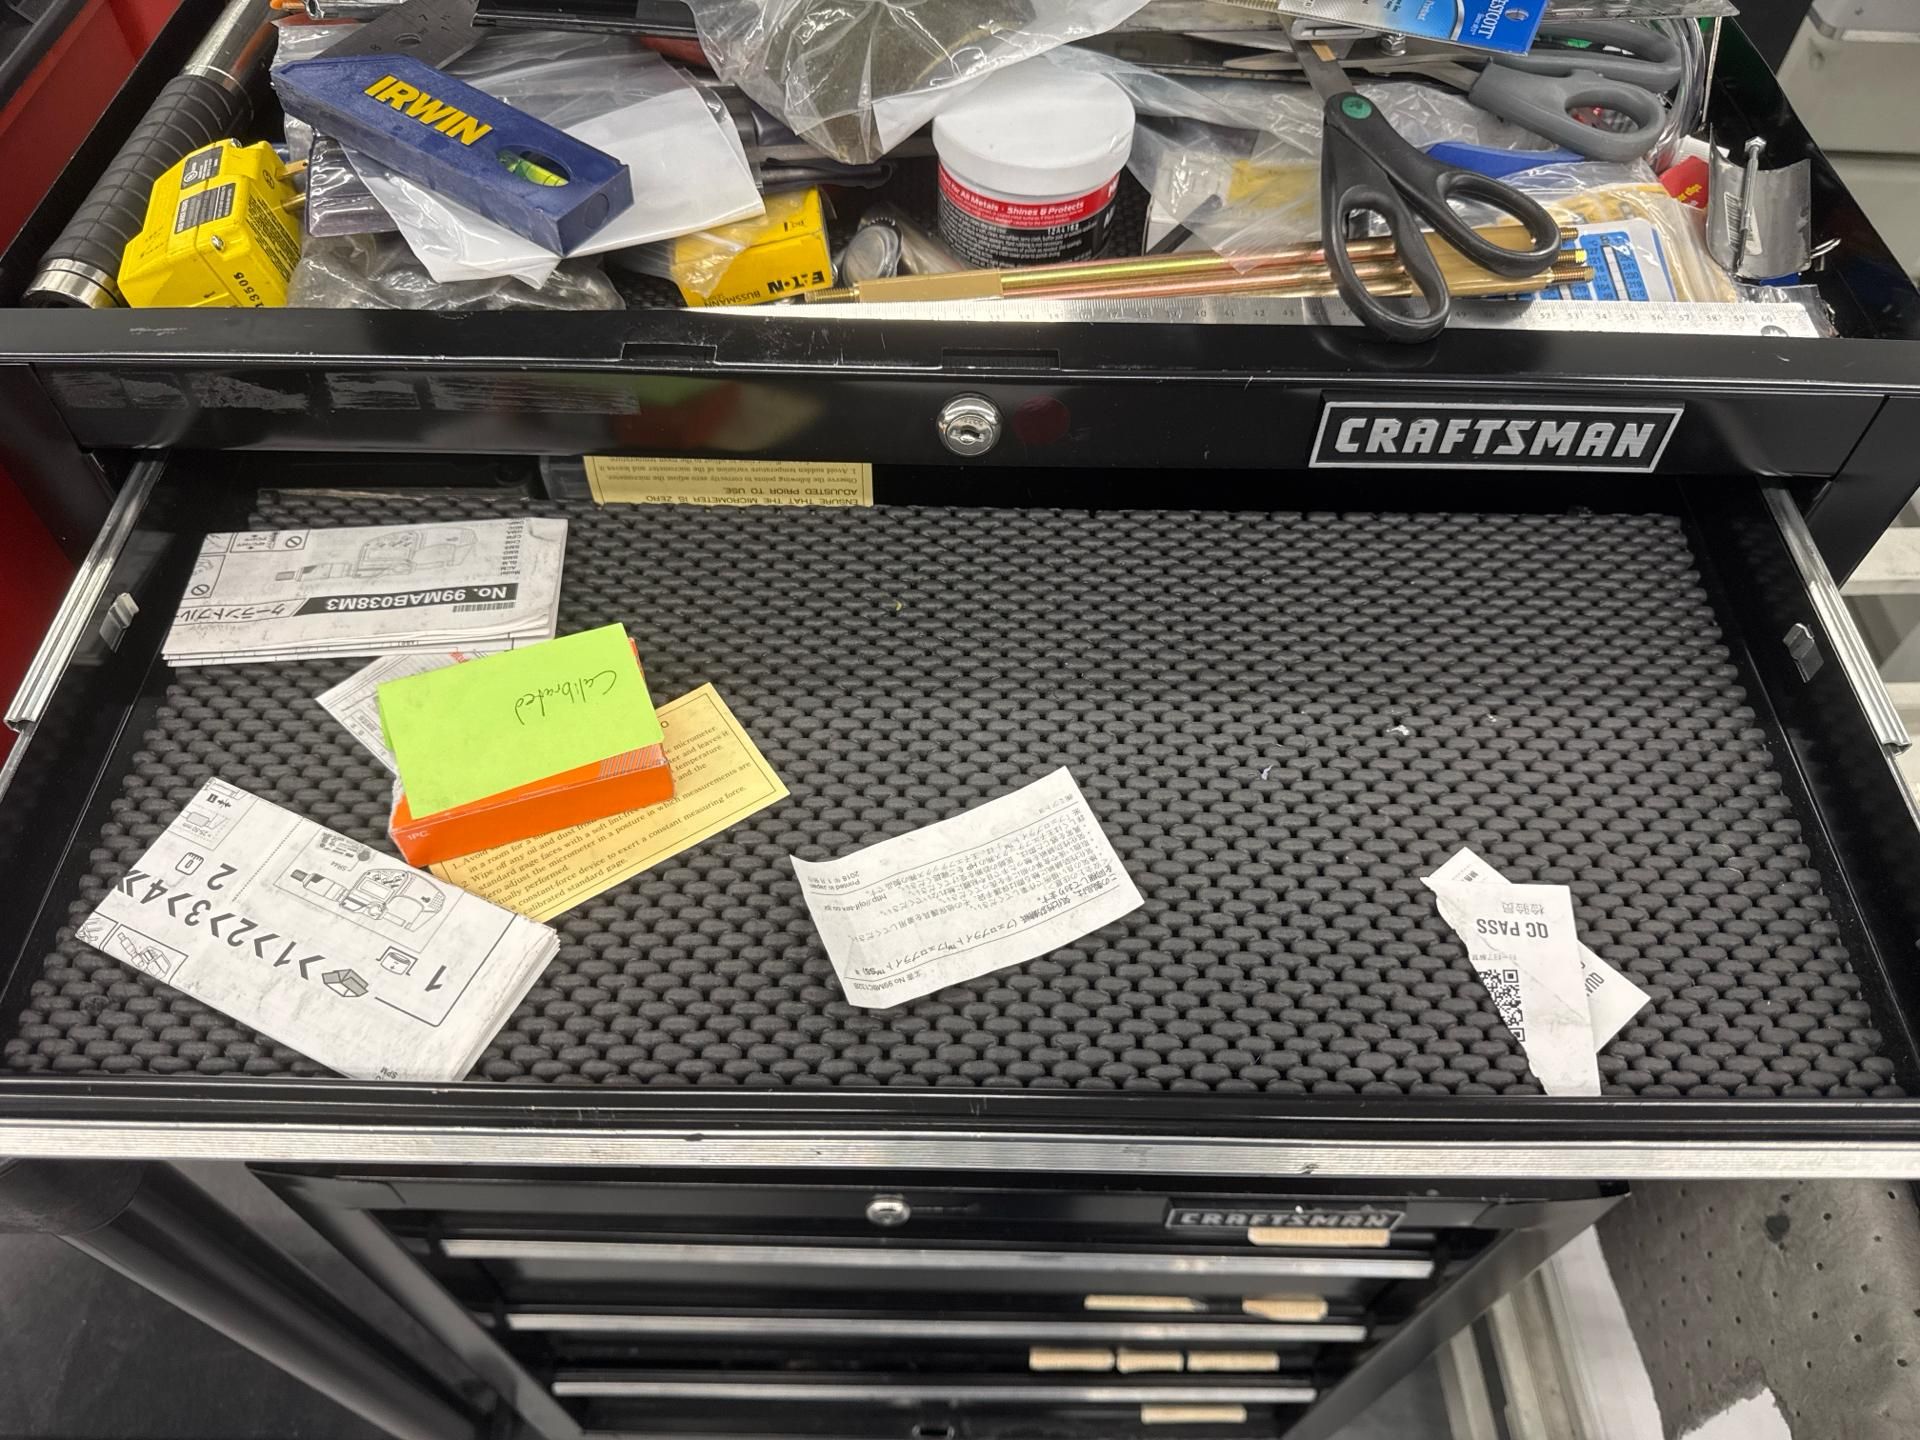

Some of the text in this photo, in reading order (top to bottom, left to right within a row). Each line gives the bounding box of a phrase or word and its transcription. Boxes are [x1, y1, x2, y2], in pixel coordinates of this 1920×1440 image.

[364, 74, 494, 146] IRWIN
[1007, 206, 1038, 216] Shines
[1048, 201, 1084, 216] Protects
[767, 270, 824, 293] EATON
[1334, 417, 1656, 457] CRAFTSMAN
[692, 496, 757, 504] MICROMETER
[325, 585, 507, 611] No. 99MAB038M3
[513, 669, 616, 725] Calibrated
[672, 722, 718, 752] micrometer.
[681, 746, 696, 758] and
[697, 732, 722, 750] leaves
[674, 742, 723, 772] temperature.
[676, 761, 707, 781] and the
[502, 872, 531, 891] adjust
[531, 864, 547, 876] the
[547, 838, 596, 869] micrometer
[597, 834, 607, 843] in
[614, 813, 646, 834] posture
[646, 808, 655, 817] in
[655, 794, 681, 812] which
[681, 766, 737, 801] measurements
[737, 760, 751, 772] are
[576, 854, 607, 875] device
[606, 851, 616, 860] to
[616, 839, 640, 855] exert
[647, 816, 682, 839] constant
[682, 794, 725, 822] measuring
[461, 846, 488, 865] Avoid
[468, 864, 478, 873] in
[486, 848, 510, 864] room
[510, 841, 523, 852] for
[470, 866, 495, 884] Wipe
[494, 859, 508, 871] off
[507, 852, 525, 866] any
[525, 845, 538, 856] oil
[537, 836, 555, 850] and
[555, 826, 575, 841] dust
[476, 866, 517, 893] standard
[517, 856, 540, 872] gage
[539, 843, 563, 861] faces
[563, 833, 583, 849] with
[589, 821, 607, 835] soft
[205, 861, 237, 893] 2
[522, 888, 566, 916] calibrated
[565, 868, 604, 893] standard
[139, 877, 296, 966] 1 2 3 4
[1501, 902, 1543, 915] 检验员
[1475, 918, 1548, 938] QC PASS
[423, 964, 447, 991] 1
[379, 1065, 398, 1078] SPM
[1180, 1212, 1389, 1227] CRAFTSMAN
